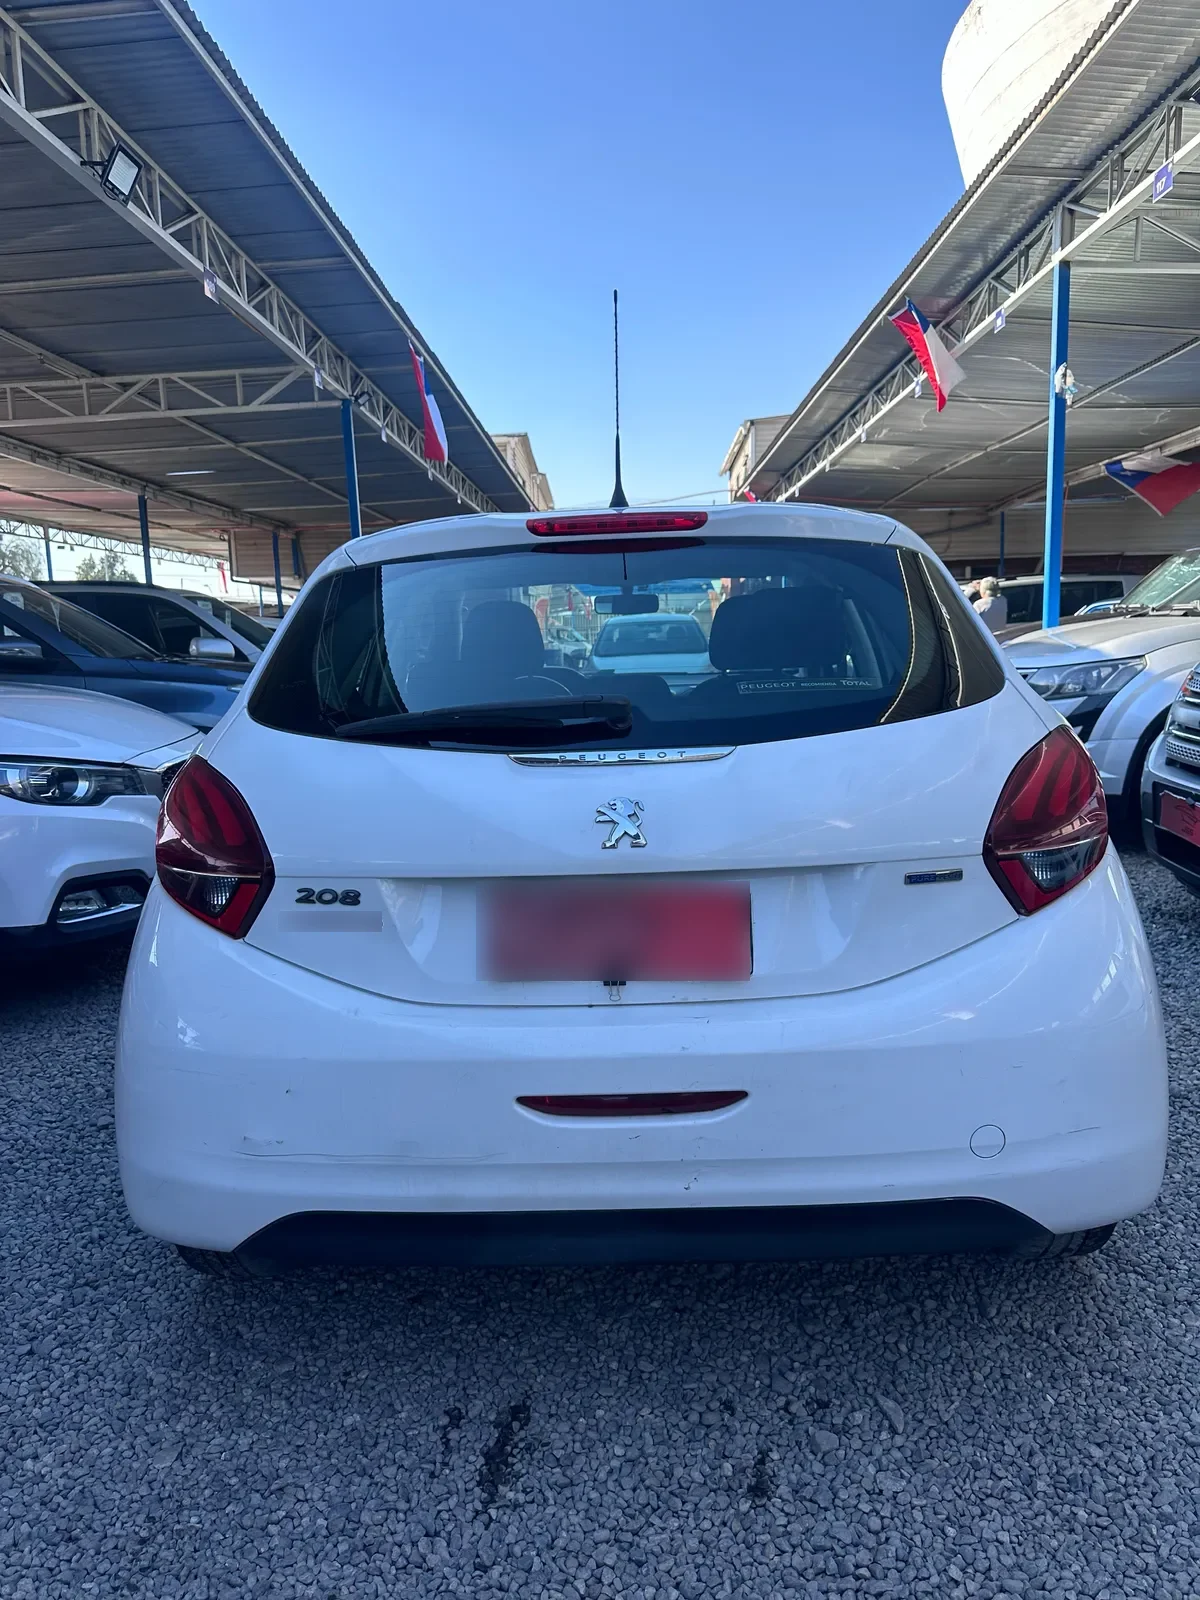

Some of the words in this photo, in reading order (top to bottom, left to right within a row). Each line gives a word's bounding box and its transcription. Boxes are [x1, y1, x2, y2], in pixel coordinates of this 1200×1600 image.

[740, 681, 797, 690] PEUGEOT
[840, 679, 872, 687] TOTAL
[558, 751, 686, 763] PEUGEOT
[295, 887, 361, 906] 208
